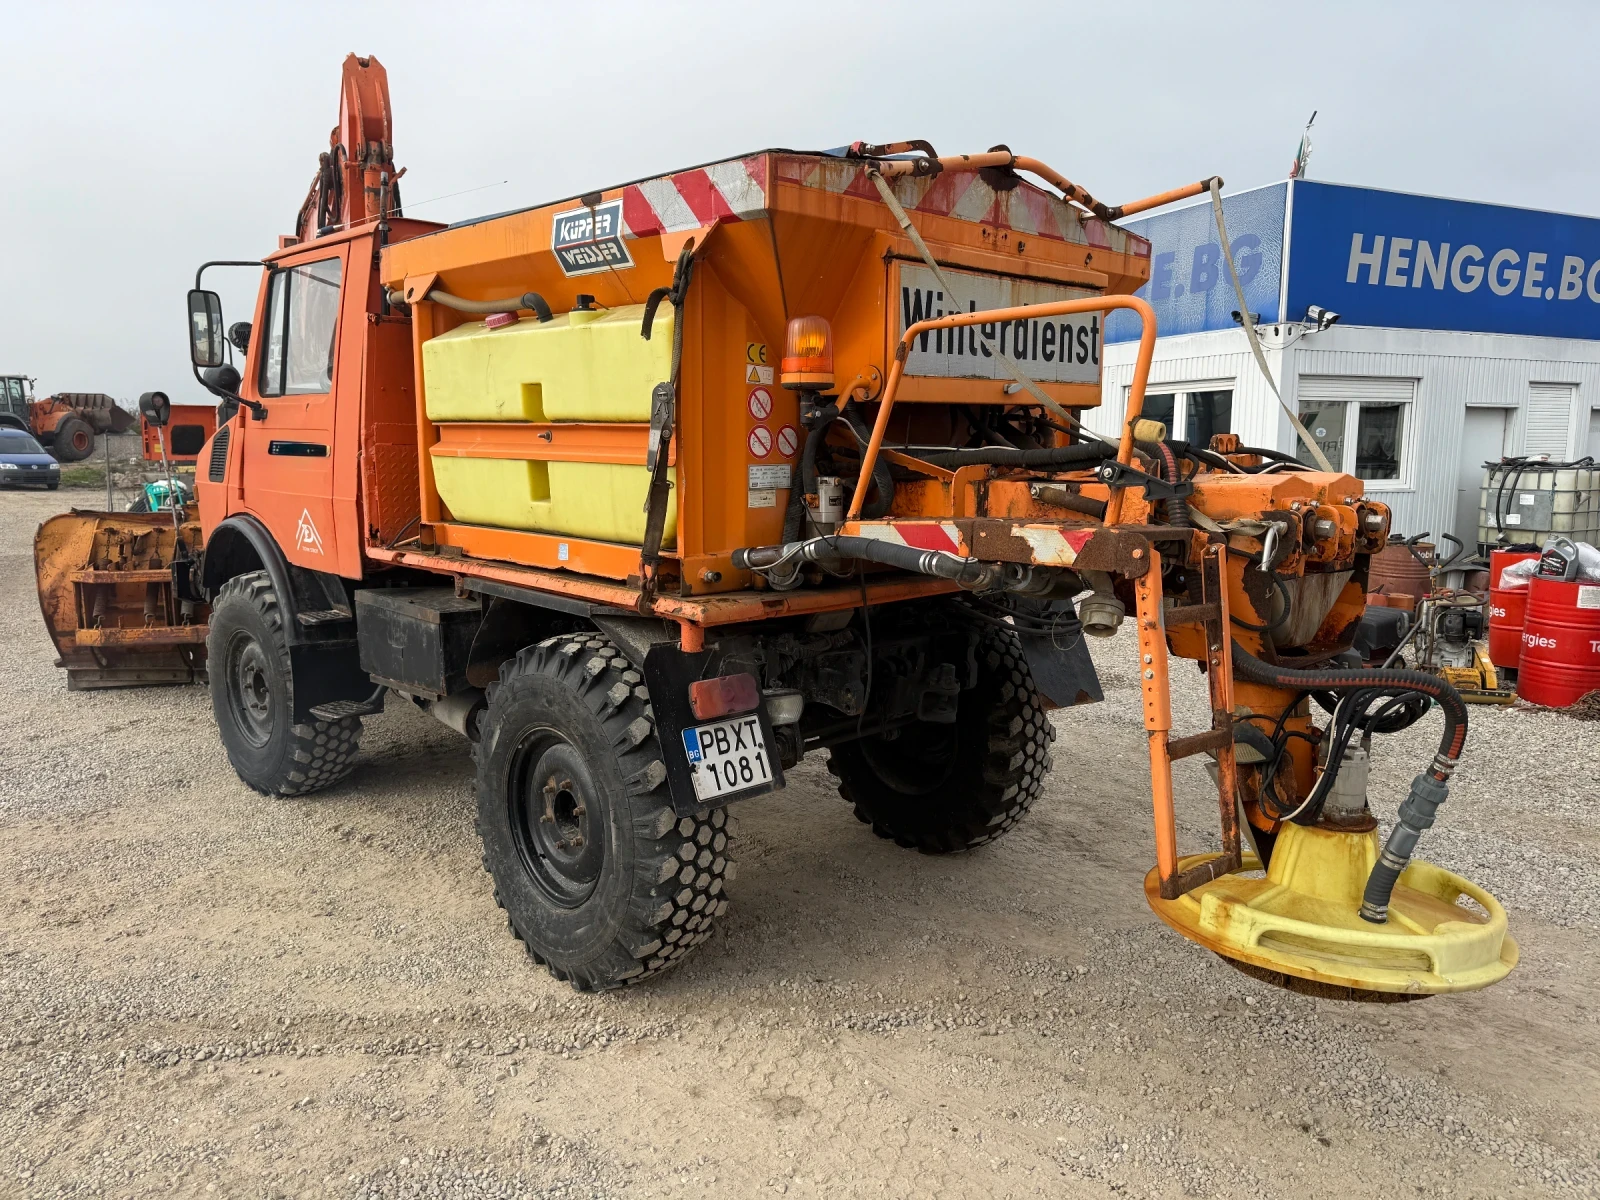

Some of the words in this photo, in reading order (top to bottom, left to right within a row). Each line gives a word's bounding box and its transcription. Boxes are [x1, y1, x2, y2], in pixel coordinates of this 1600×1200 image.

[1133, 234, 1262, 300] E.BG
[903, 287, 1099, 365] Winterdienst
[689, 749, 700, 760] BG
[699, 720, 757, 759] PBXT
[709, 752, 767, 790] 1081
